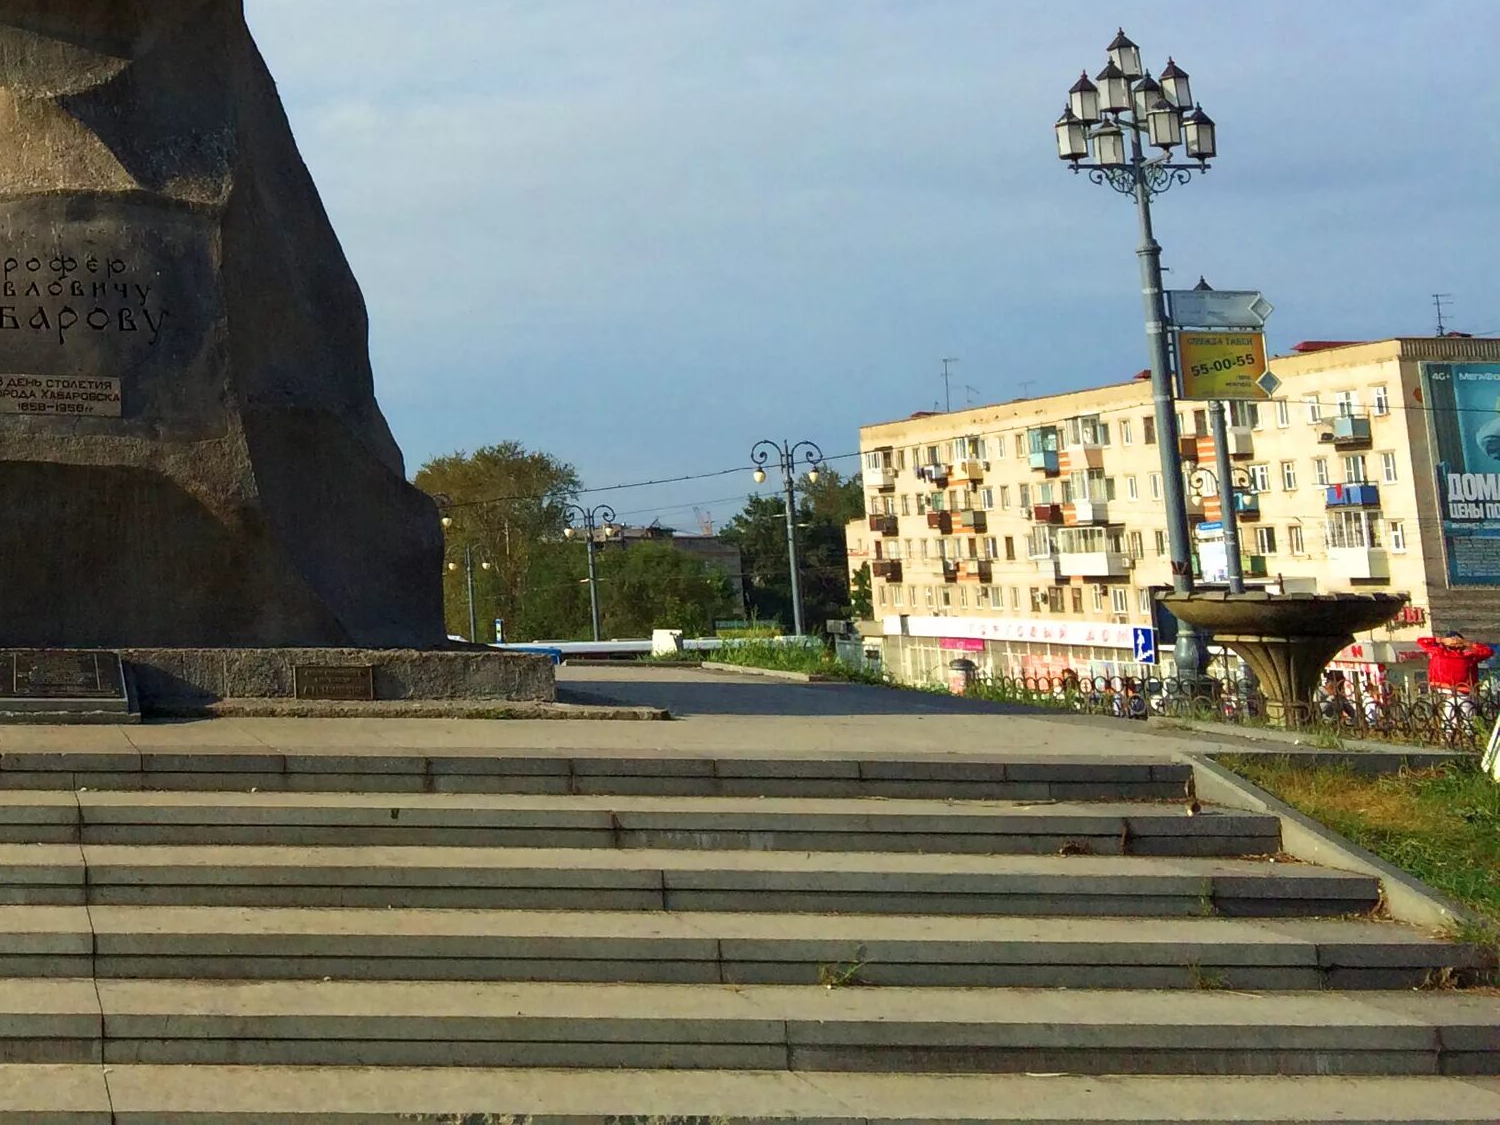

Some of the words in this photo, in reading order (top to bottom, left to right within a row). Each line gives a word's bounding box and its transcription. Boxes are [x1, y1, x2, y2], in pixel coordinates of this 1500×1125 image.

[1191, 353, 1255, 377] 55-00-55
[7, 377, 42, 388] ДЕНЬ
[46, 379, 112, 390] СТОЛЕТИЯ
[1431, 372, 1451, 381] 4G+
[1449, 503, 1485, 519] ЦЕНЫ
